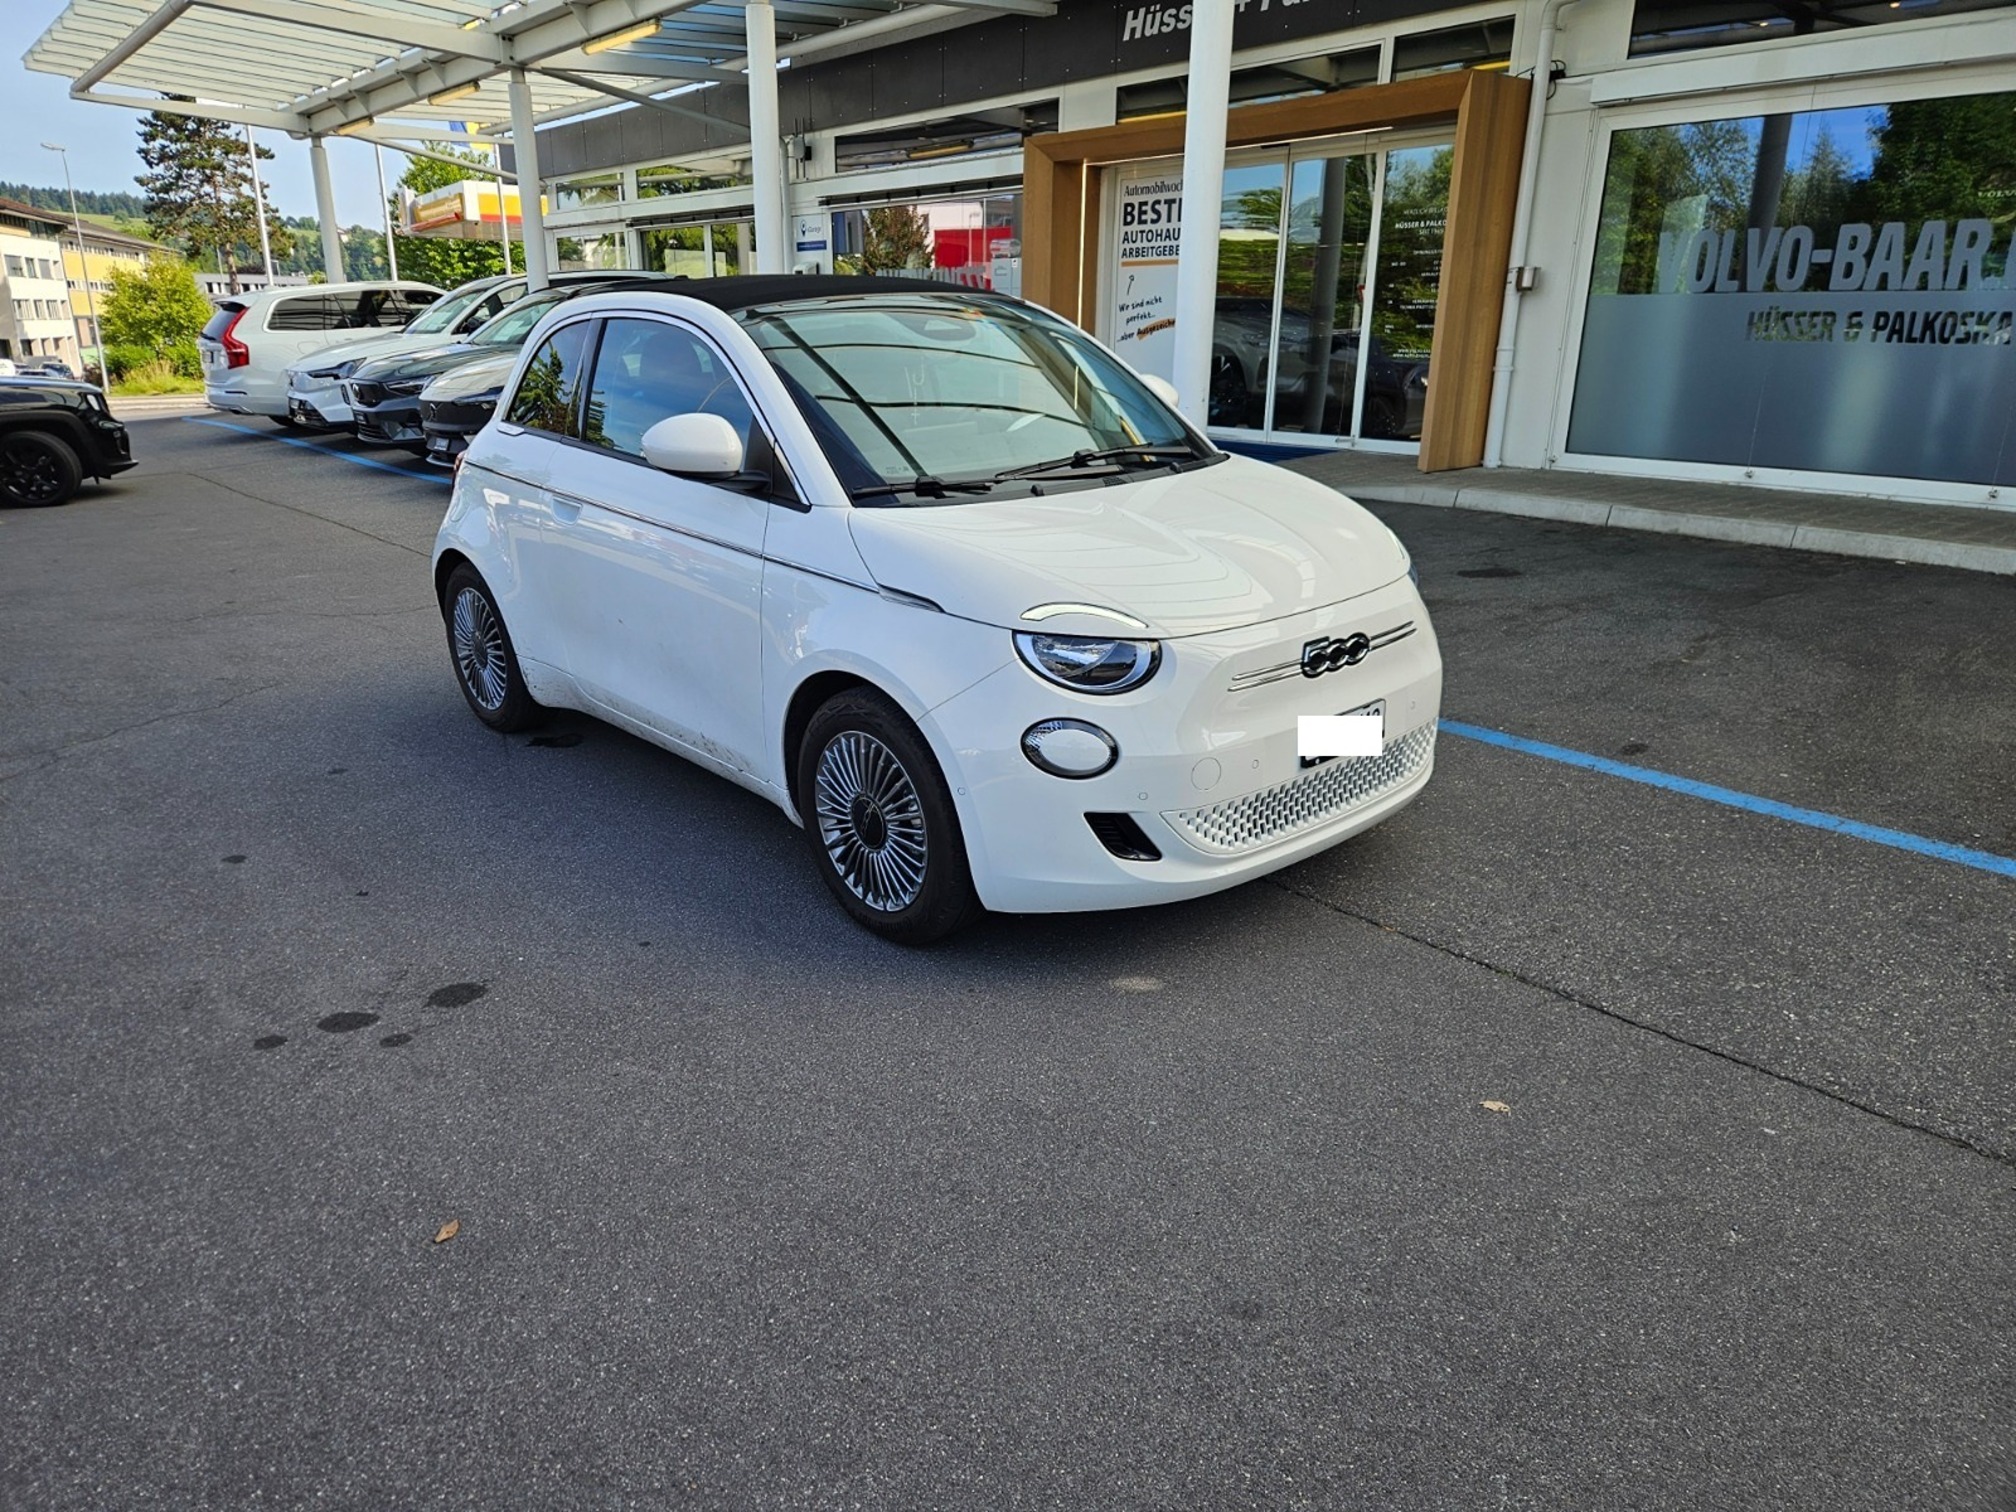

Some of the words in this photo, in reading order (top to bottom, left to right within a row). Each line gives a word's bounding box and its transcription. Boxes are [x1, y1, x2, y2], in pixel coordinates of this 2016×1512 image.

[1122, 4, 1193, 42] Hüss
[1124, 180, 1184, 197] Automobilwoc
[1977, 190, 2016, 198] VOLV
[1122, 228, 1181, 244] AUTOHAU
[1121, 245, 1180, 258] ARBEITGEBE
[1657, 218, 2016, 292] VOLVO-BAAR.
[1746, 306, 1836, 342] HÜSSER
[1843, 313, 1863, 341] &
[1302, 633, 1369, 678] 500
